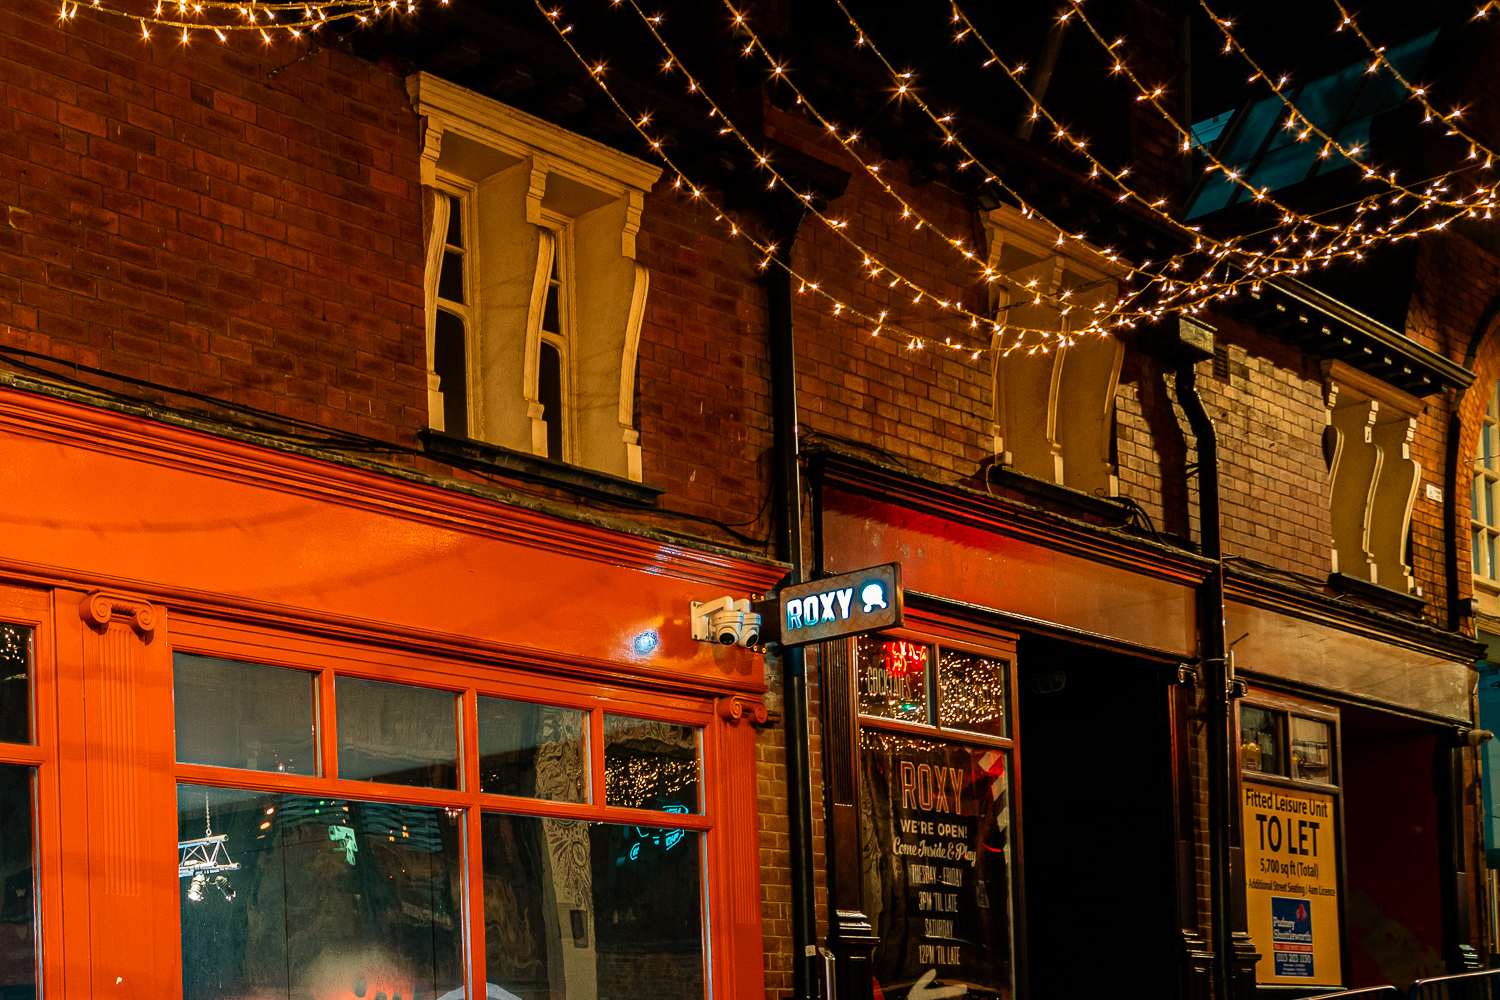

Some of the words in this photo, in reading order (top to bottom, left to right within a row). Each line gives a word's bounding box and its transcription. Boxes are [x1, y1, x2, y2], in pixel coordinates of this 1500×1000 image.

[786, 587, 854, 631] ROXY
[900, 760, 964, 815] ROXY
[1245, 788, 1273, 809] Fitted
[1275, 793, 1307, 815] Leisure
[1309, 798, 1328, 818] Unit
[900, 819, 934, 835] WE'RE
[937, 823, 968, 838] OPEN!
[1255, 813, 1282, 852] TO
[1287, 818, 1320, 857] LET
[892, 836, 917, 856] Come
[918, 840, 947, 859] Inside
[947, 842, 955, 860] &
[955, 843, 977, 867] Play
[911, 864, 937, 884] TUESDAY
[943, 867, 962, 887] FRIDAY
[1260, 858, 1280, 874] 5,700
[1280, 863, 1289, 878] sq
[1289, 860, 1297, 875] ft
[1297, 861, 1319, 880] (Total)
[918, 891, 933, 911] 3PM
[944, 893, 958, 913] LATE
[925, 918, 954, 938] SATURDAY
[918, 944, 935, 964] 12PM
[947, 946, 961, 965] LATE
